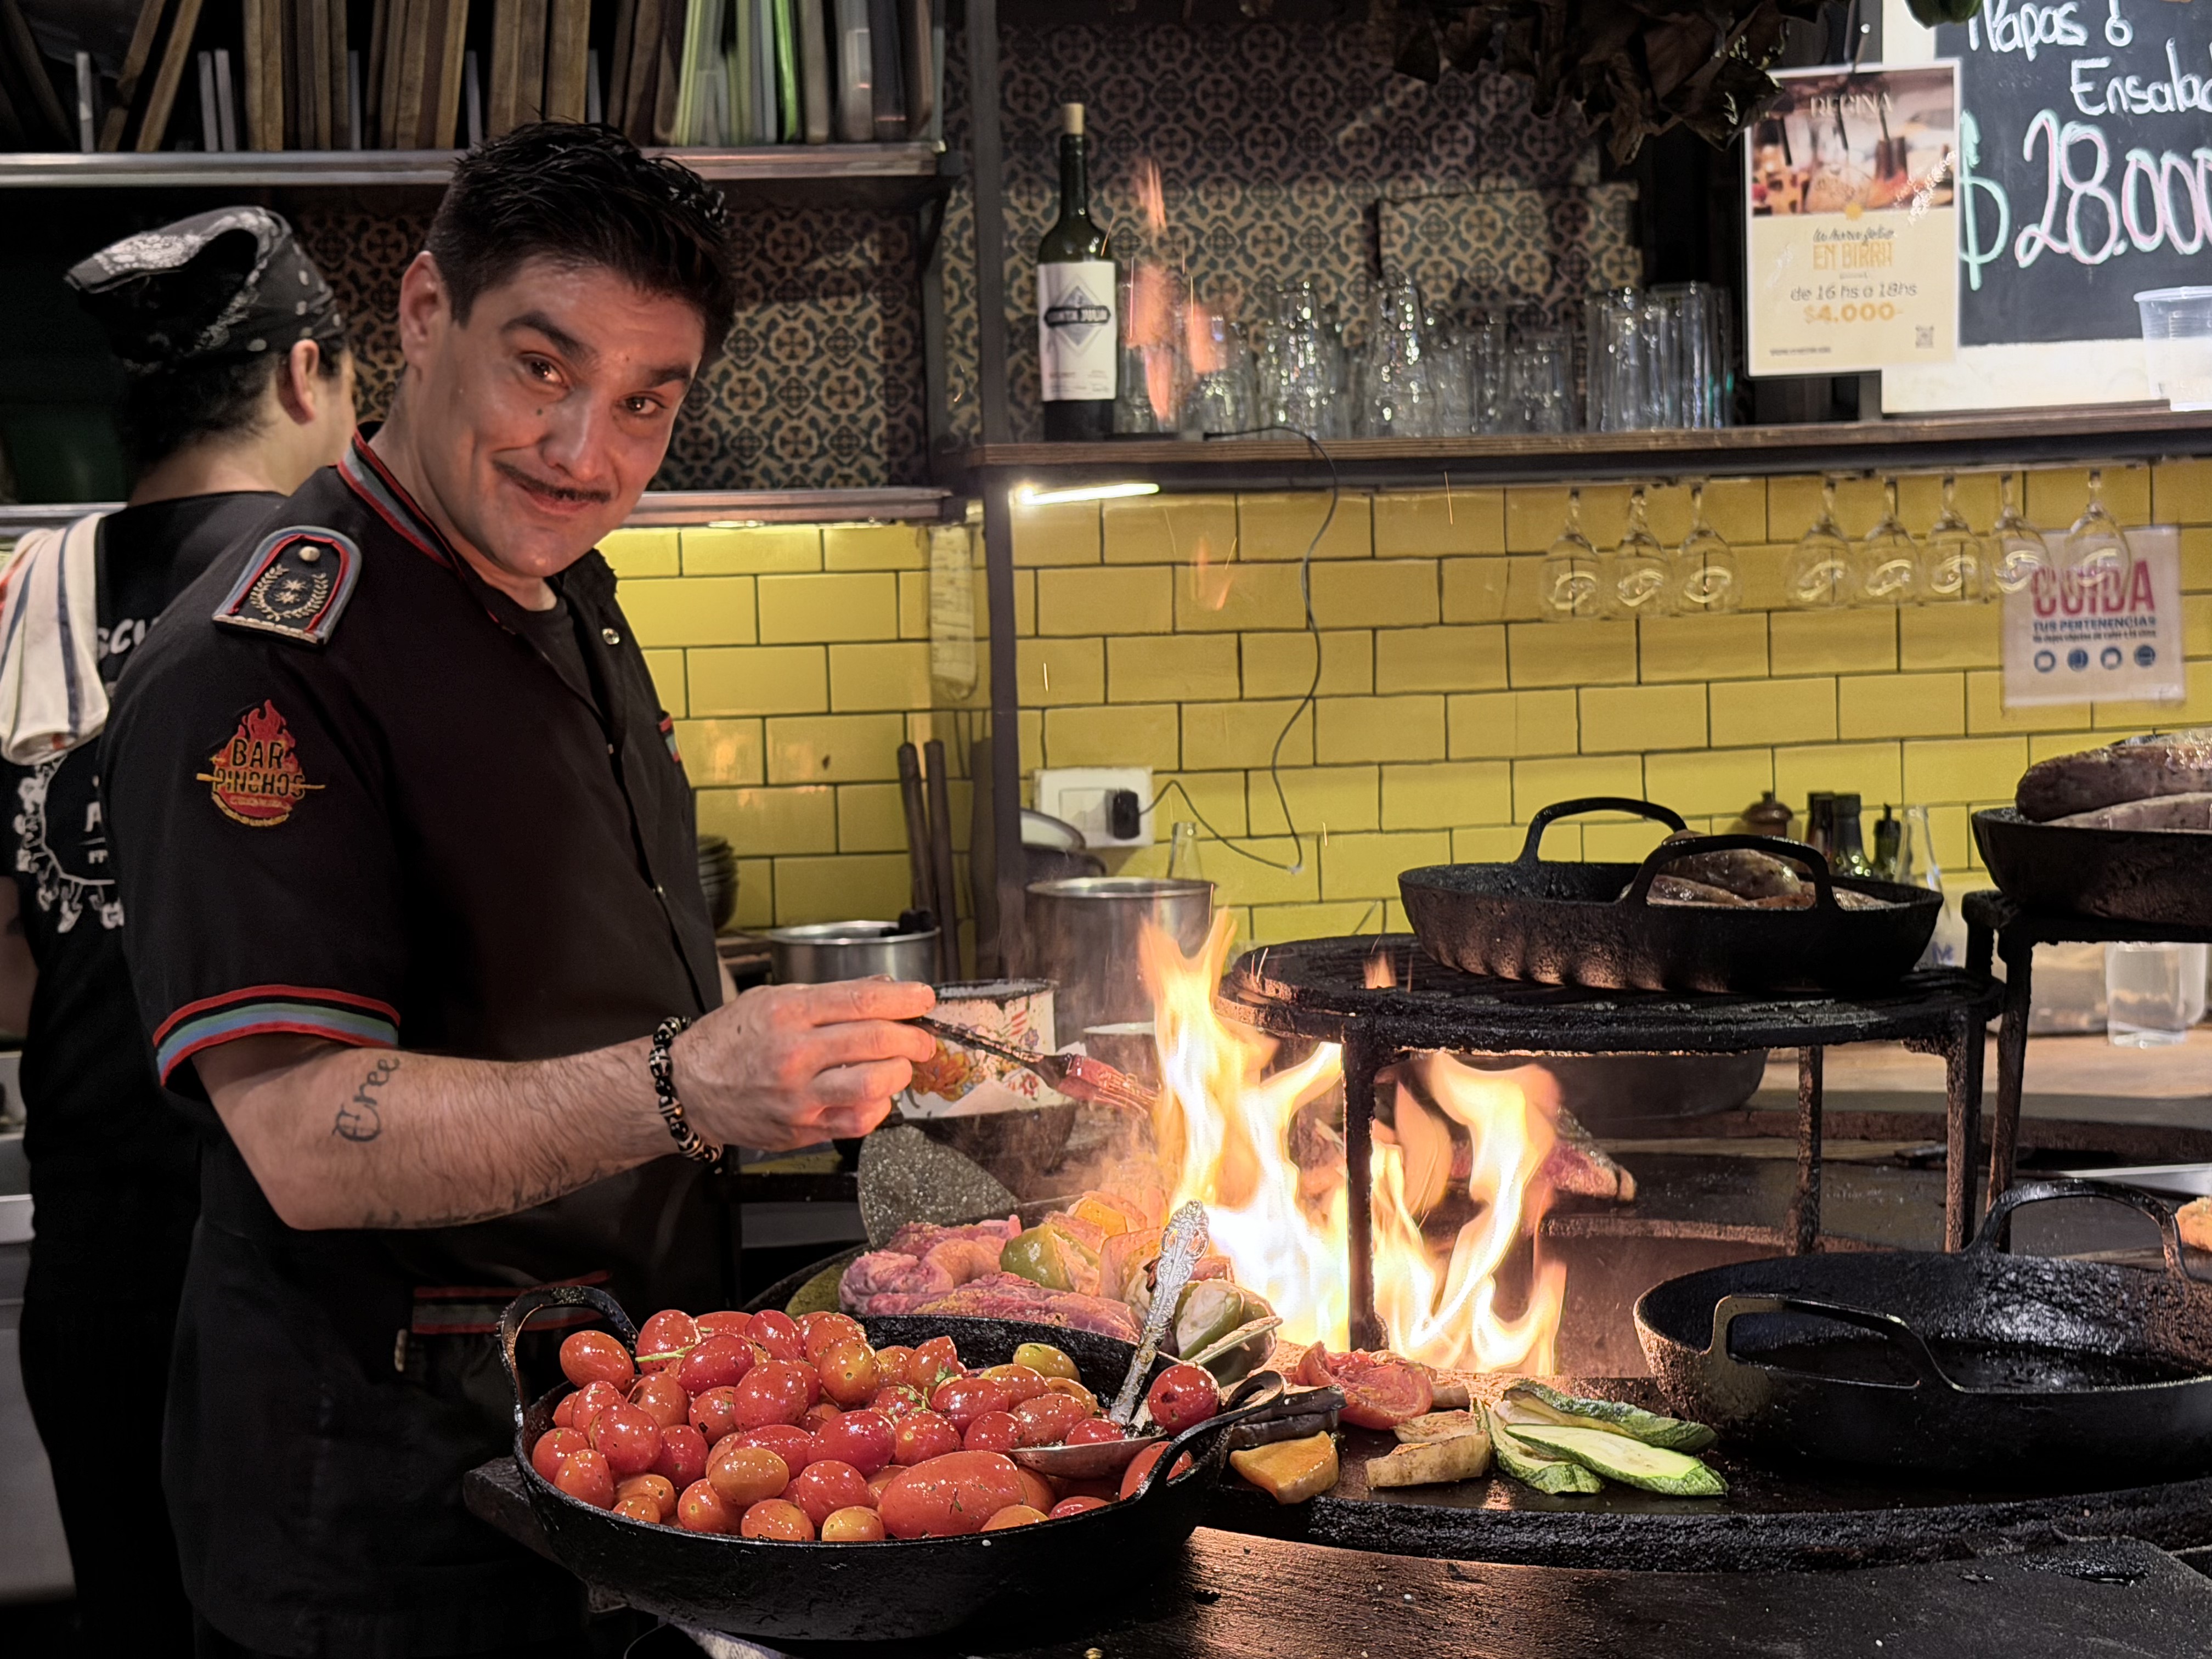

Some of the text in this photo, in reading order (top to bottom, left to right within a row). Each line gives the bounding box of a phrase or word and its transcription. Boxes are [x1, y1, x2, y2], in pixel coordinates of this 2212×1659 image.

[1791, 285, 1812, 301] de
[1816, 284, 1836, 301] 16
[2031, 560, 2155, 618] CUIDA
[2033, 616, 2157, 631] TUS PERTENENCIAS
[231, 738, 285, 769] BAR
[215, 768, 306, 798] PINCHOS
